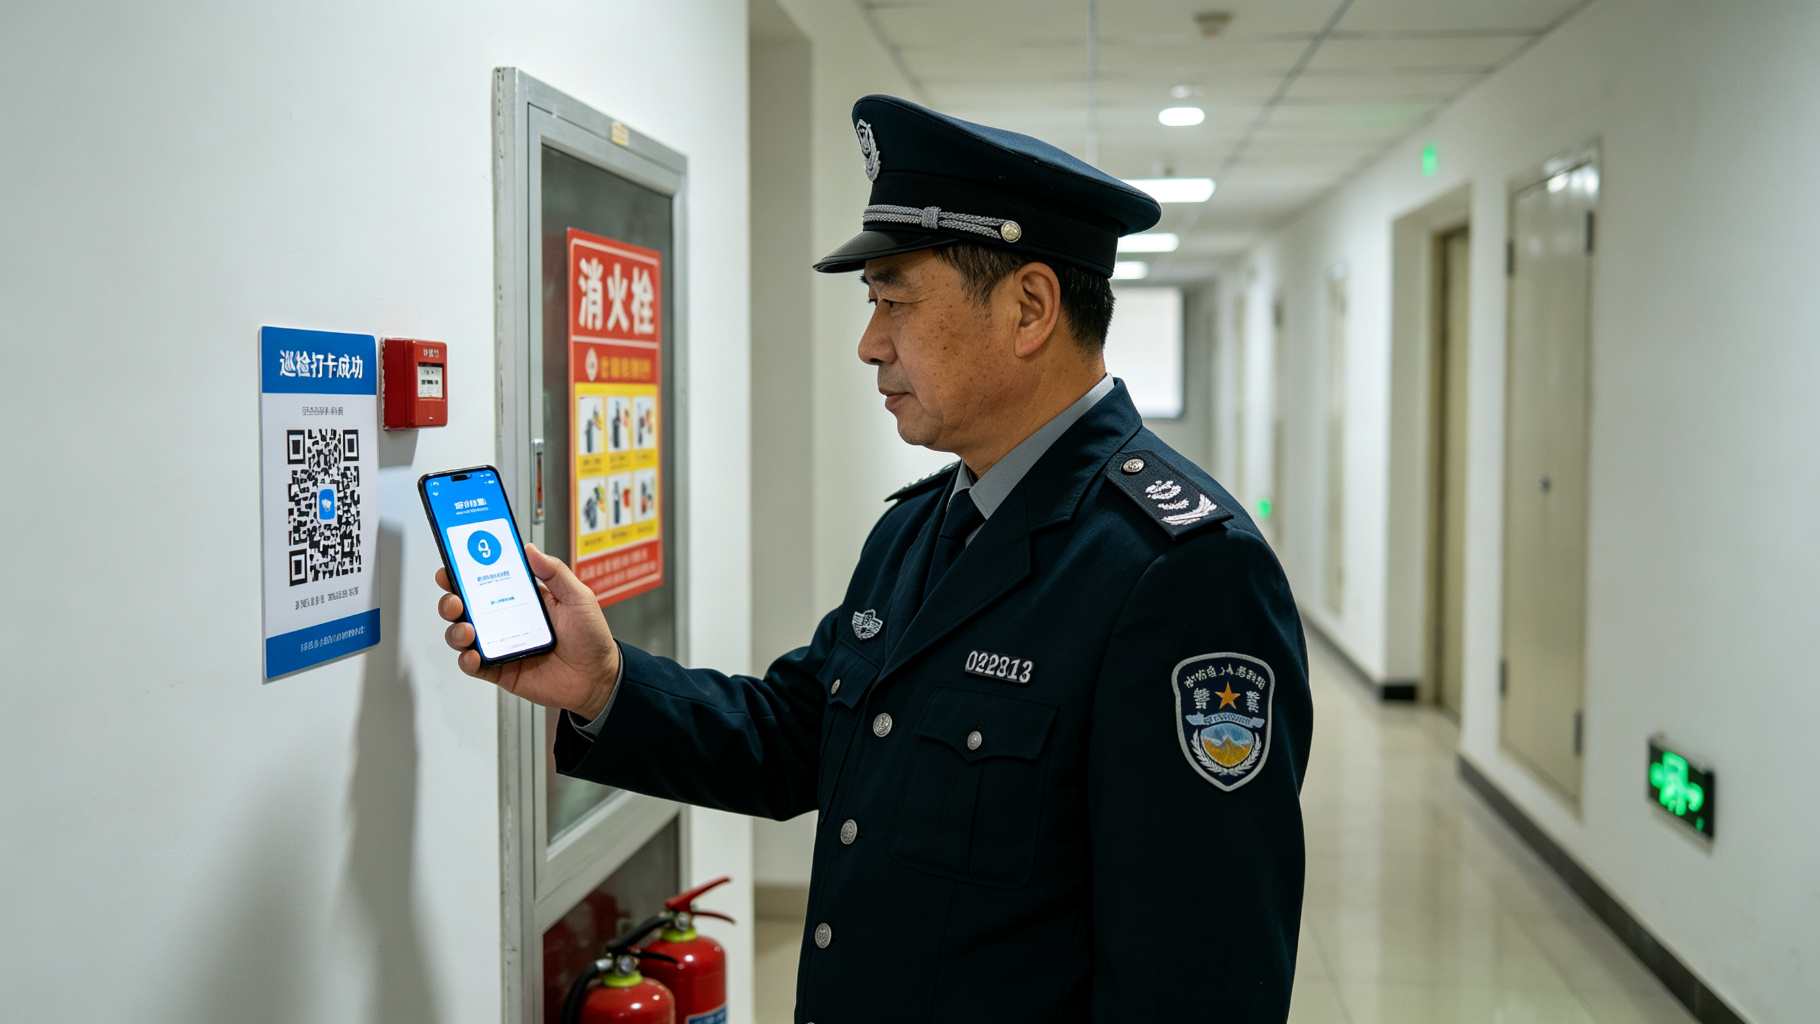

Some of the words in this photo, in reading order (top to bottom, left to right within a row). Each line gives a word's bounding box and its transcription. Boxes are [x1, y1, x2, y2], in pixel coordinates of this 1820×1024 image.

[578, 257, 655, 335] 消火栓
[965, 650, 1034, 684] 022813
